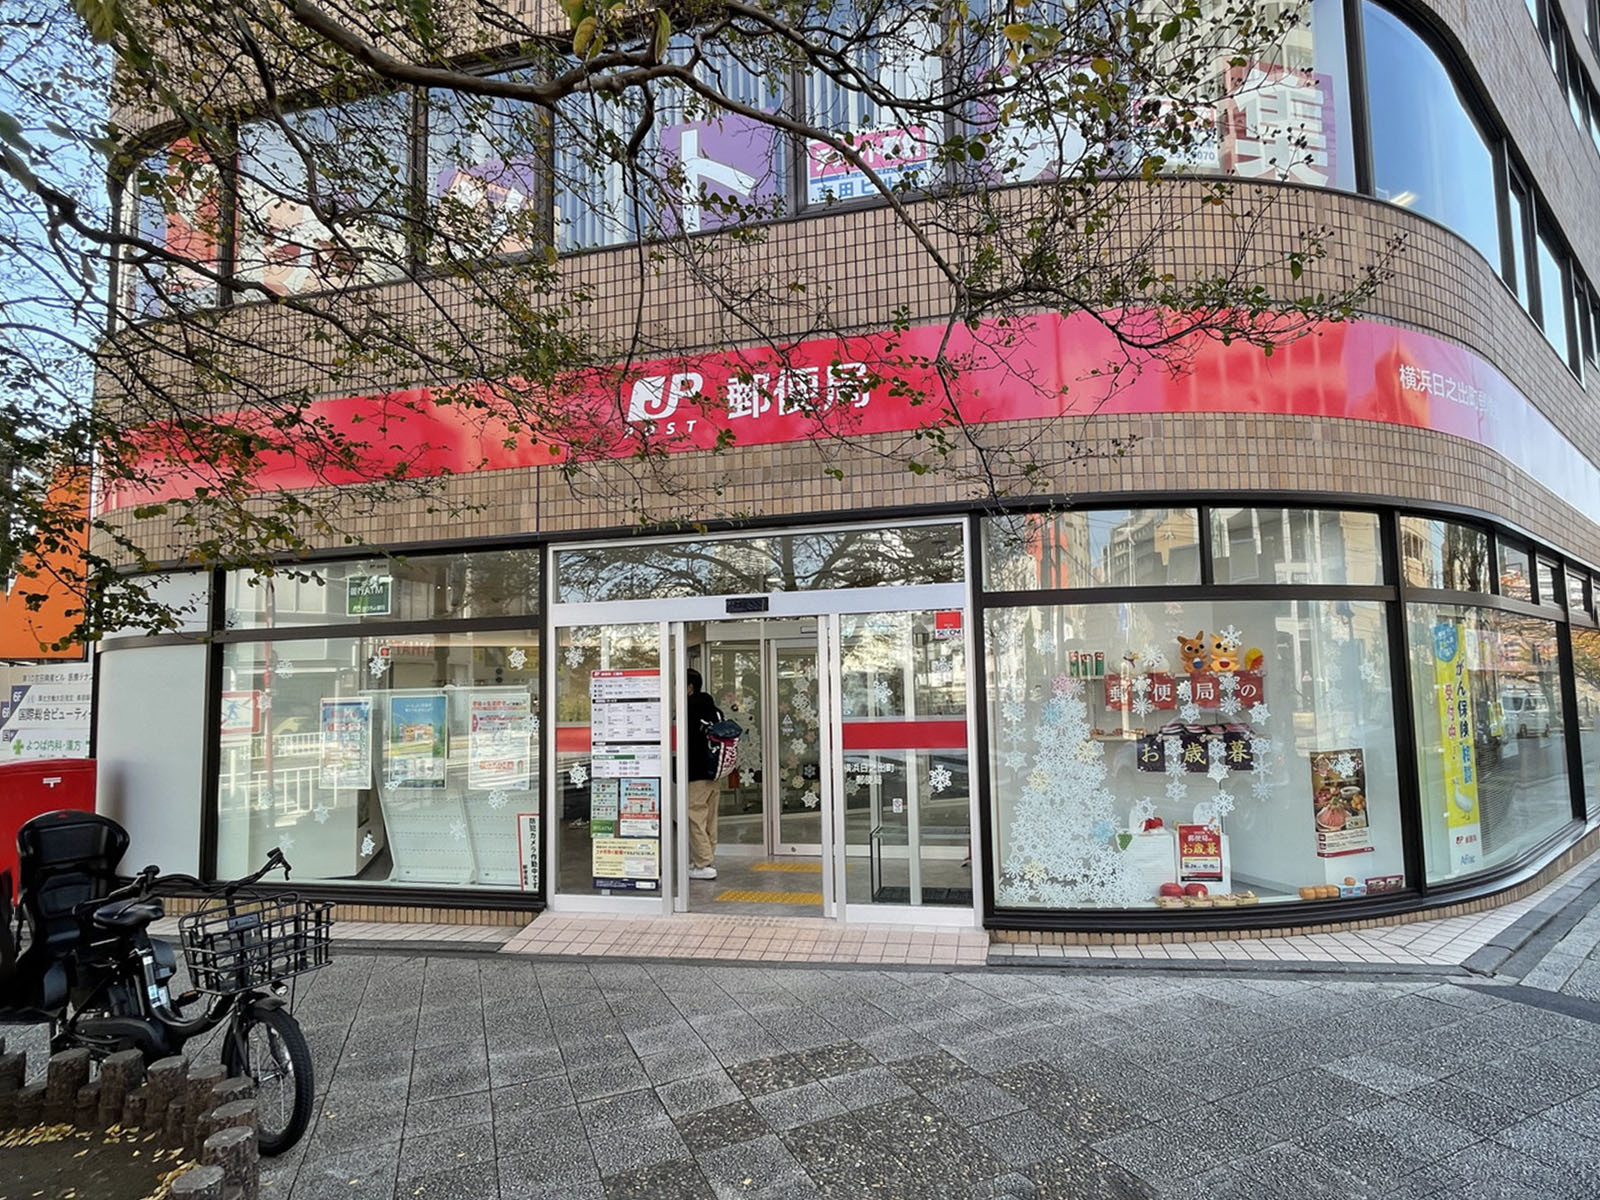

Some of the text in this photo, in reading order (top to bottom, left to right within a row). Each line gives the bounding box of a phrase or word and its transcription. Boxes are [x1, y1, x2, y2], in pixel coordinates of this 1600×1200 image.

[726, 362, 870, 420] 郵便局
[1141, 740, 1252, 765] お歳暮
